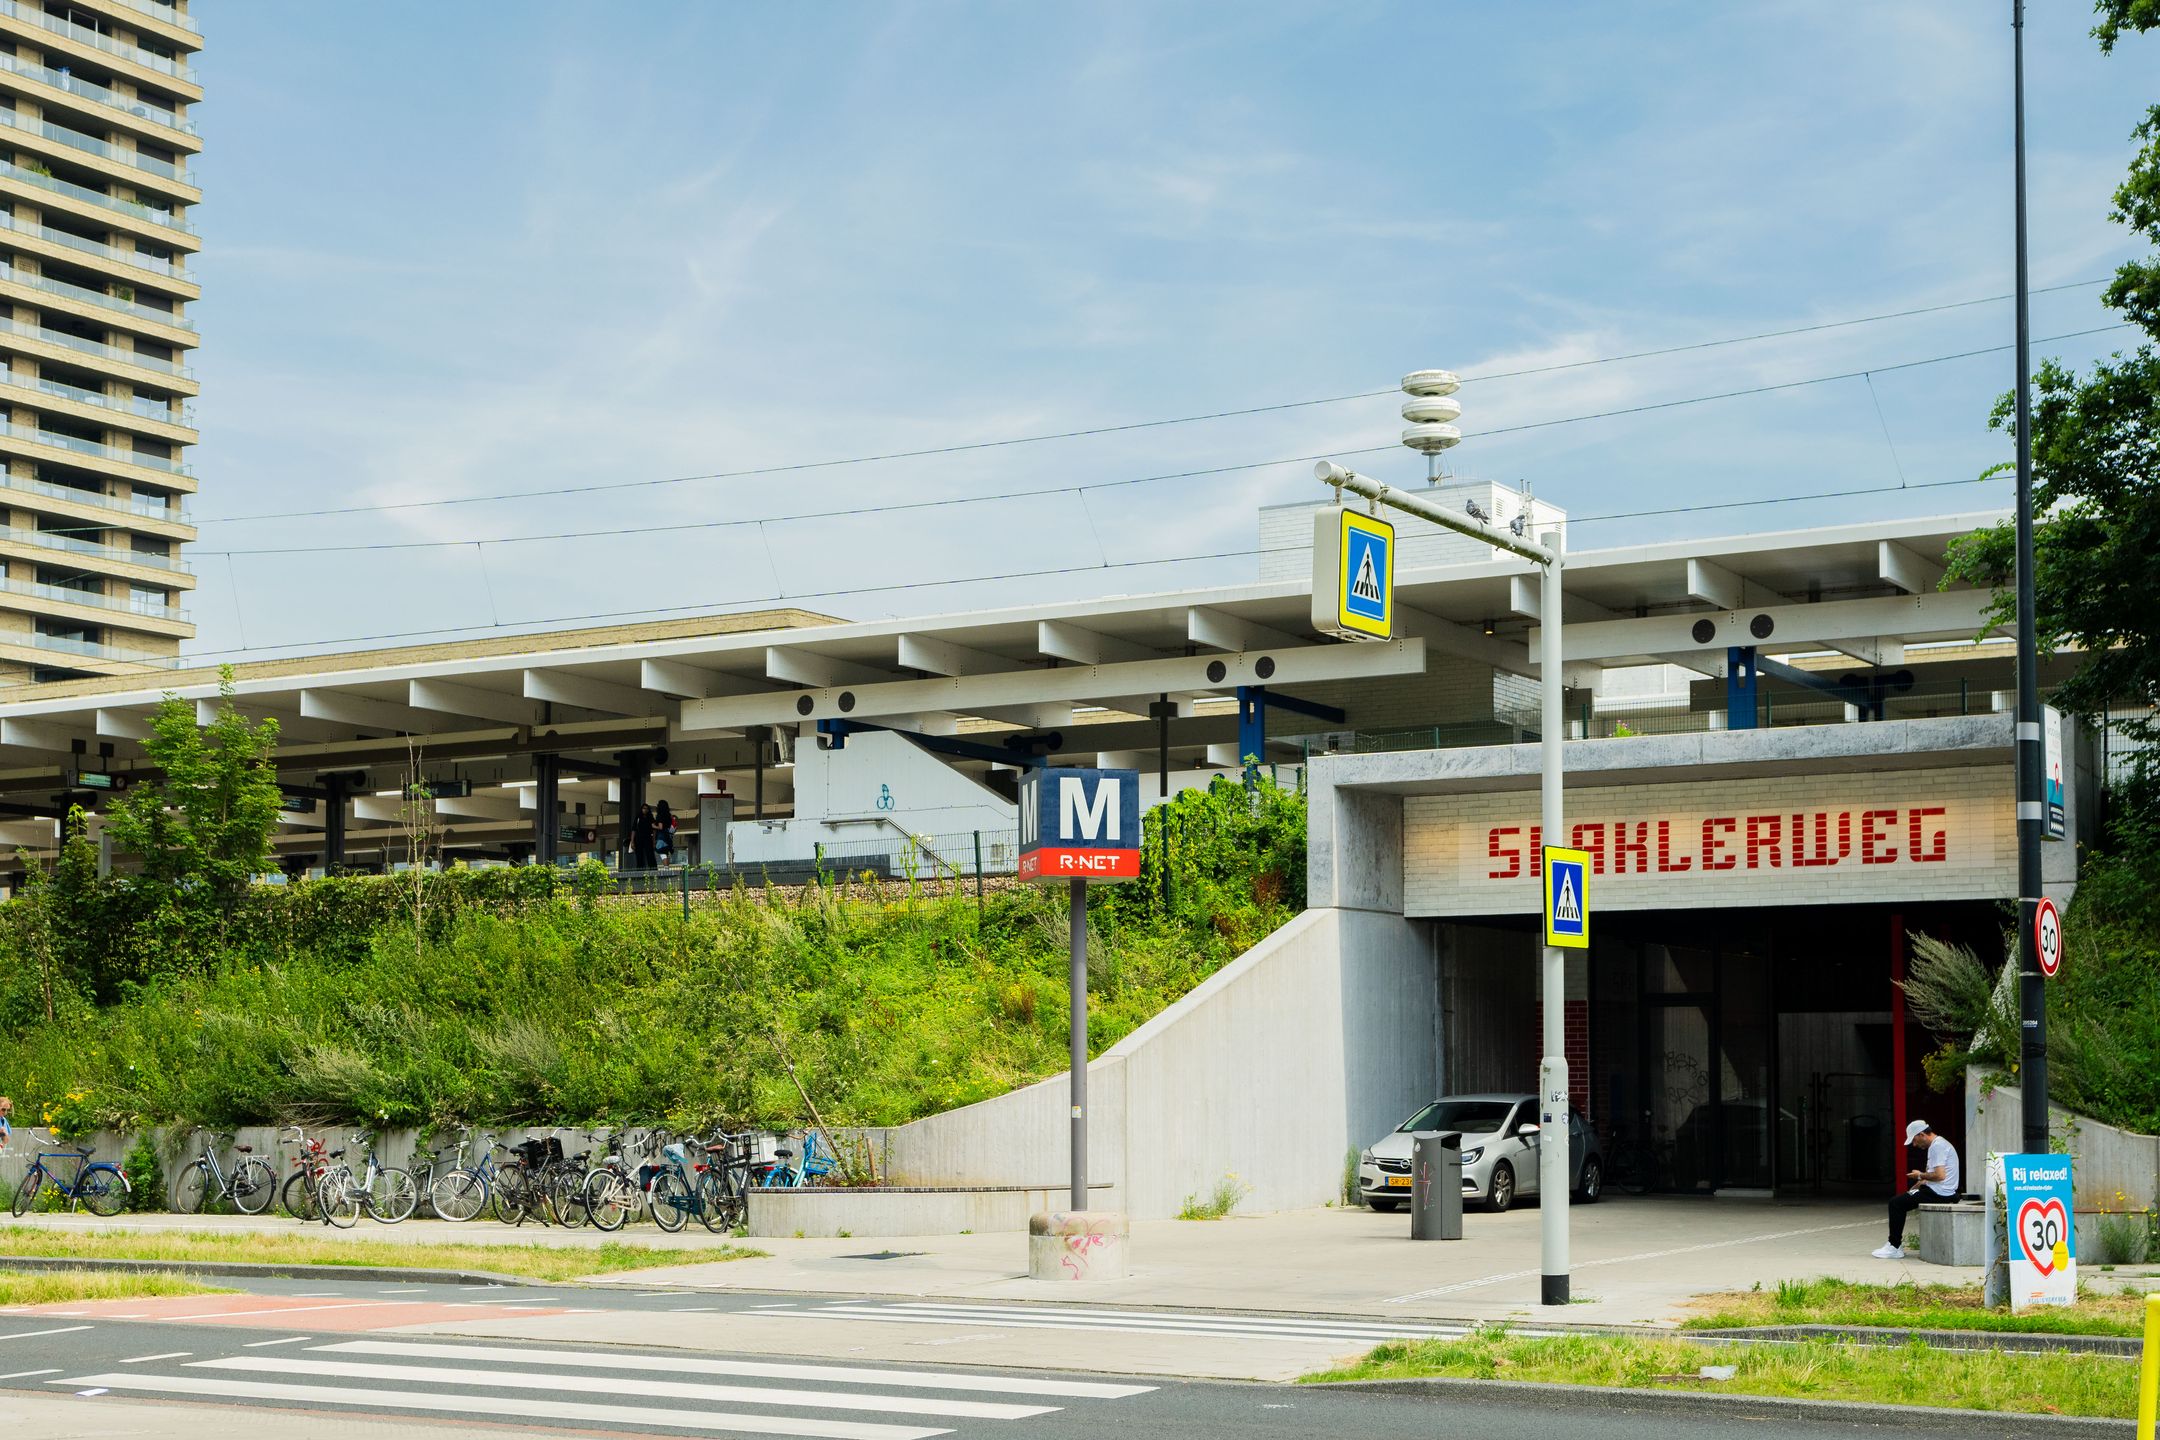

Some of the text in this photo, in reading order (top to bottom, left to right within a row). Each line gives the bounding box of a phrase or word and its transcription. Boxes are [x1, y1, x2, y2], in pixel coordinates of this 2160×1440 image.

[1022, 779, 1038, 845] M
[1060, 777, 1120, 840] M
[2042, 925, 2056, 955] 30
[2012, 1168, 2068, 1184] Rij relaxed!
[2031, 1220, 2058, 1251] 30
